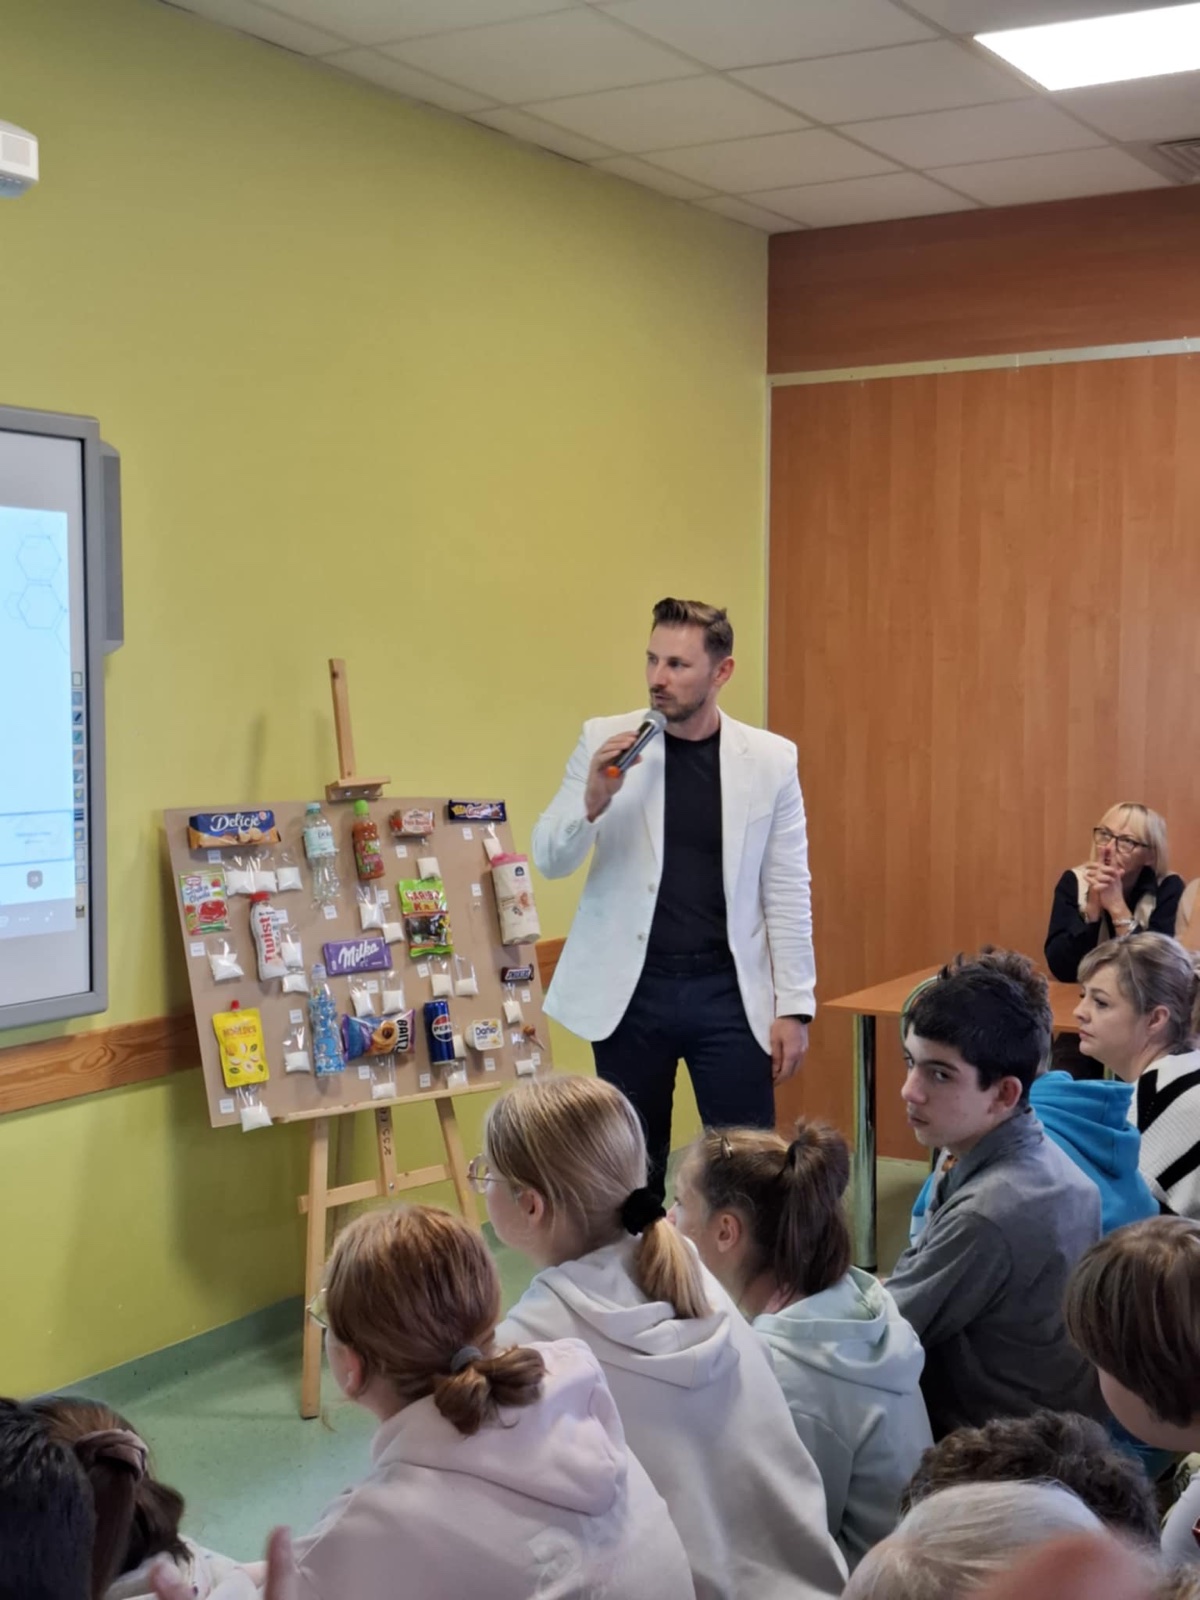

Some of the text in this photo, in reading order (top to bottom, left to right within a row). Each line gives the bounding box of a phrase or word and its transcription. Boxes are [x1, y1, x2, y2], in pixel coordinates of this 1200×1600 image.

[209, 812, 261, 832] Delicje
[259, 916, 276, 964] Twist
[338, 940, 380, 969] Milka
